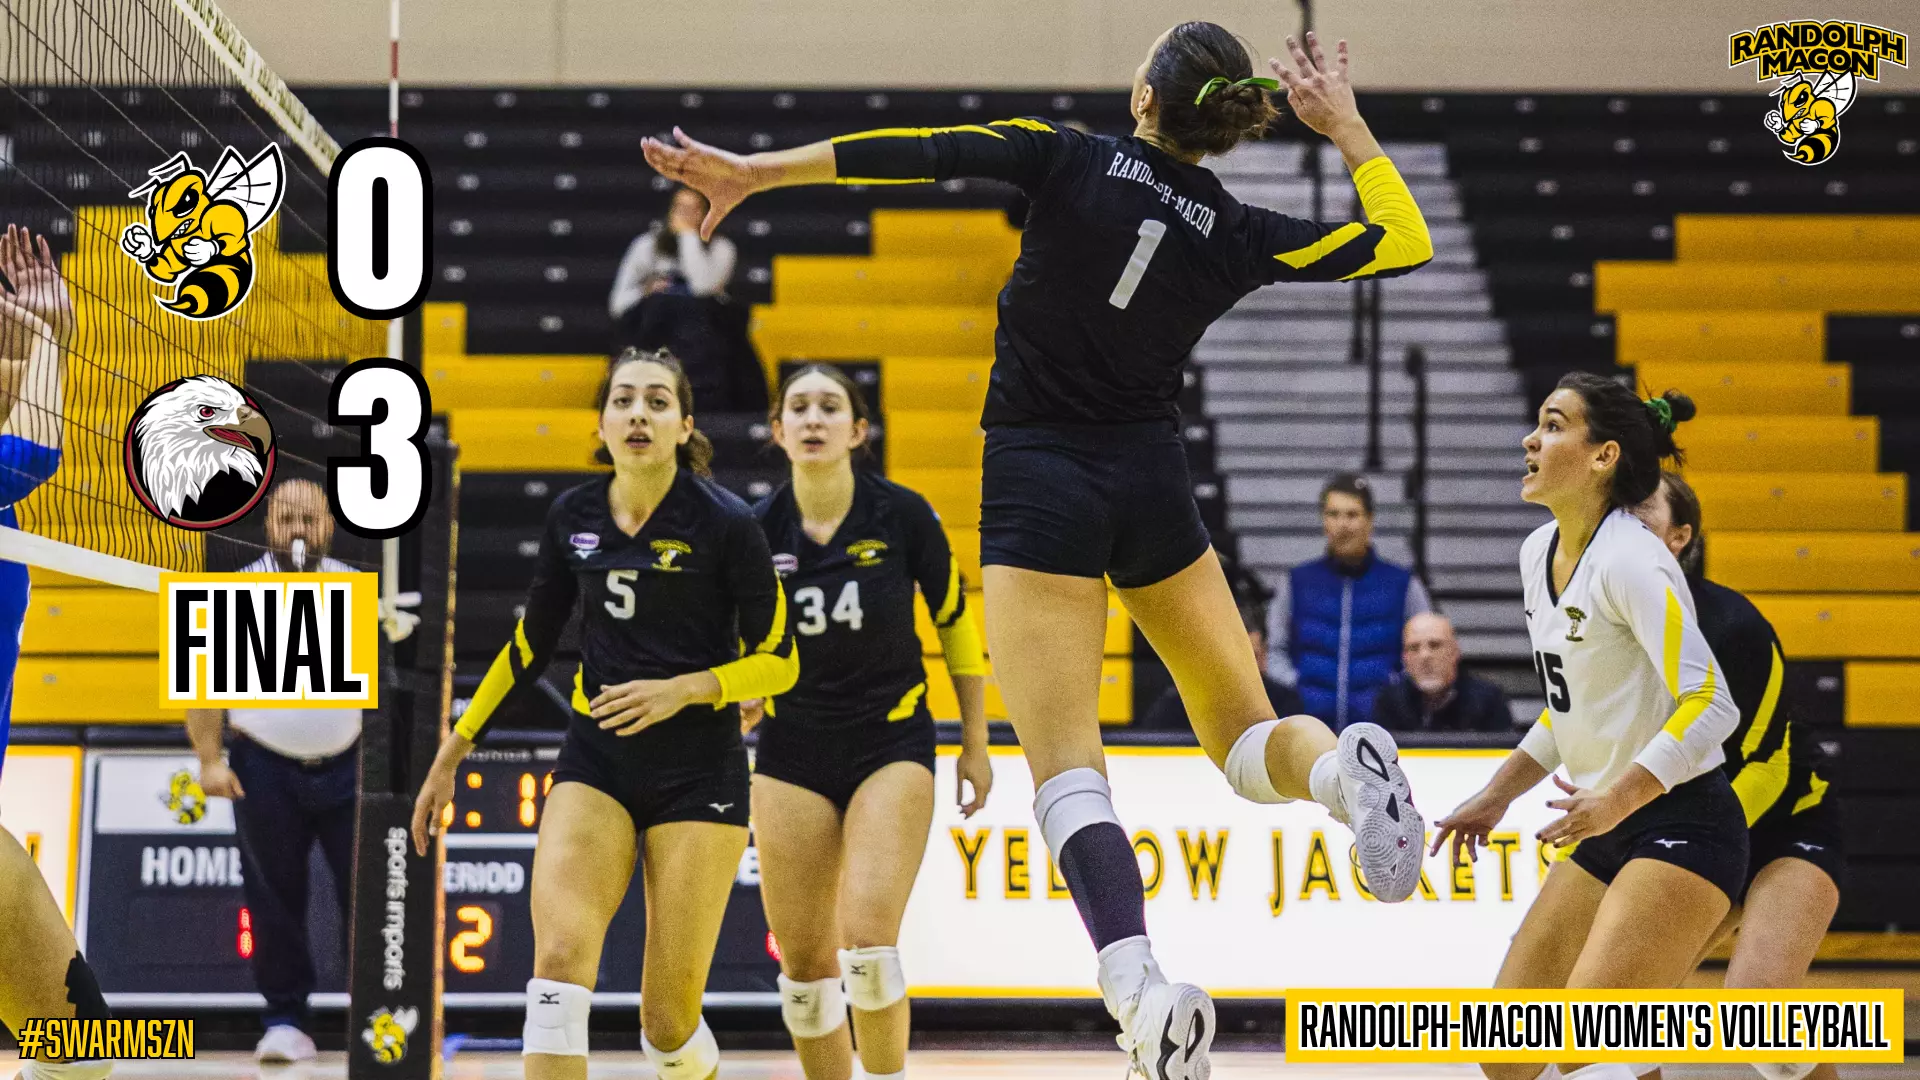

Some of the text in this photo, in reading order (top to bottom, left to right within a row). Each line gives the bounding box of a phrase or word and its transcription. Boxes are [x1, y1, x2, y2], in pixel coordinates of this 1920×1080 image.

[1109, 219, 1167, 310] 1
[604, 569, 639, 619] 5
[794, 580, 864, 636] 34
[381, 826, 409, 991] sports imports
[443, 861, 525, 894] ERIOD
[449, 905, 494, 973] 2
